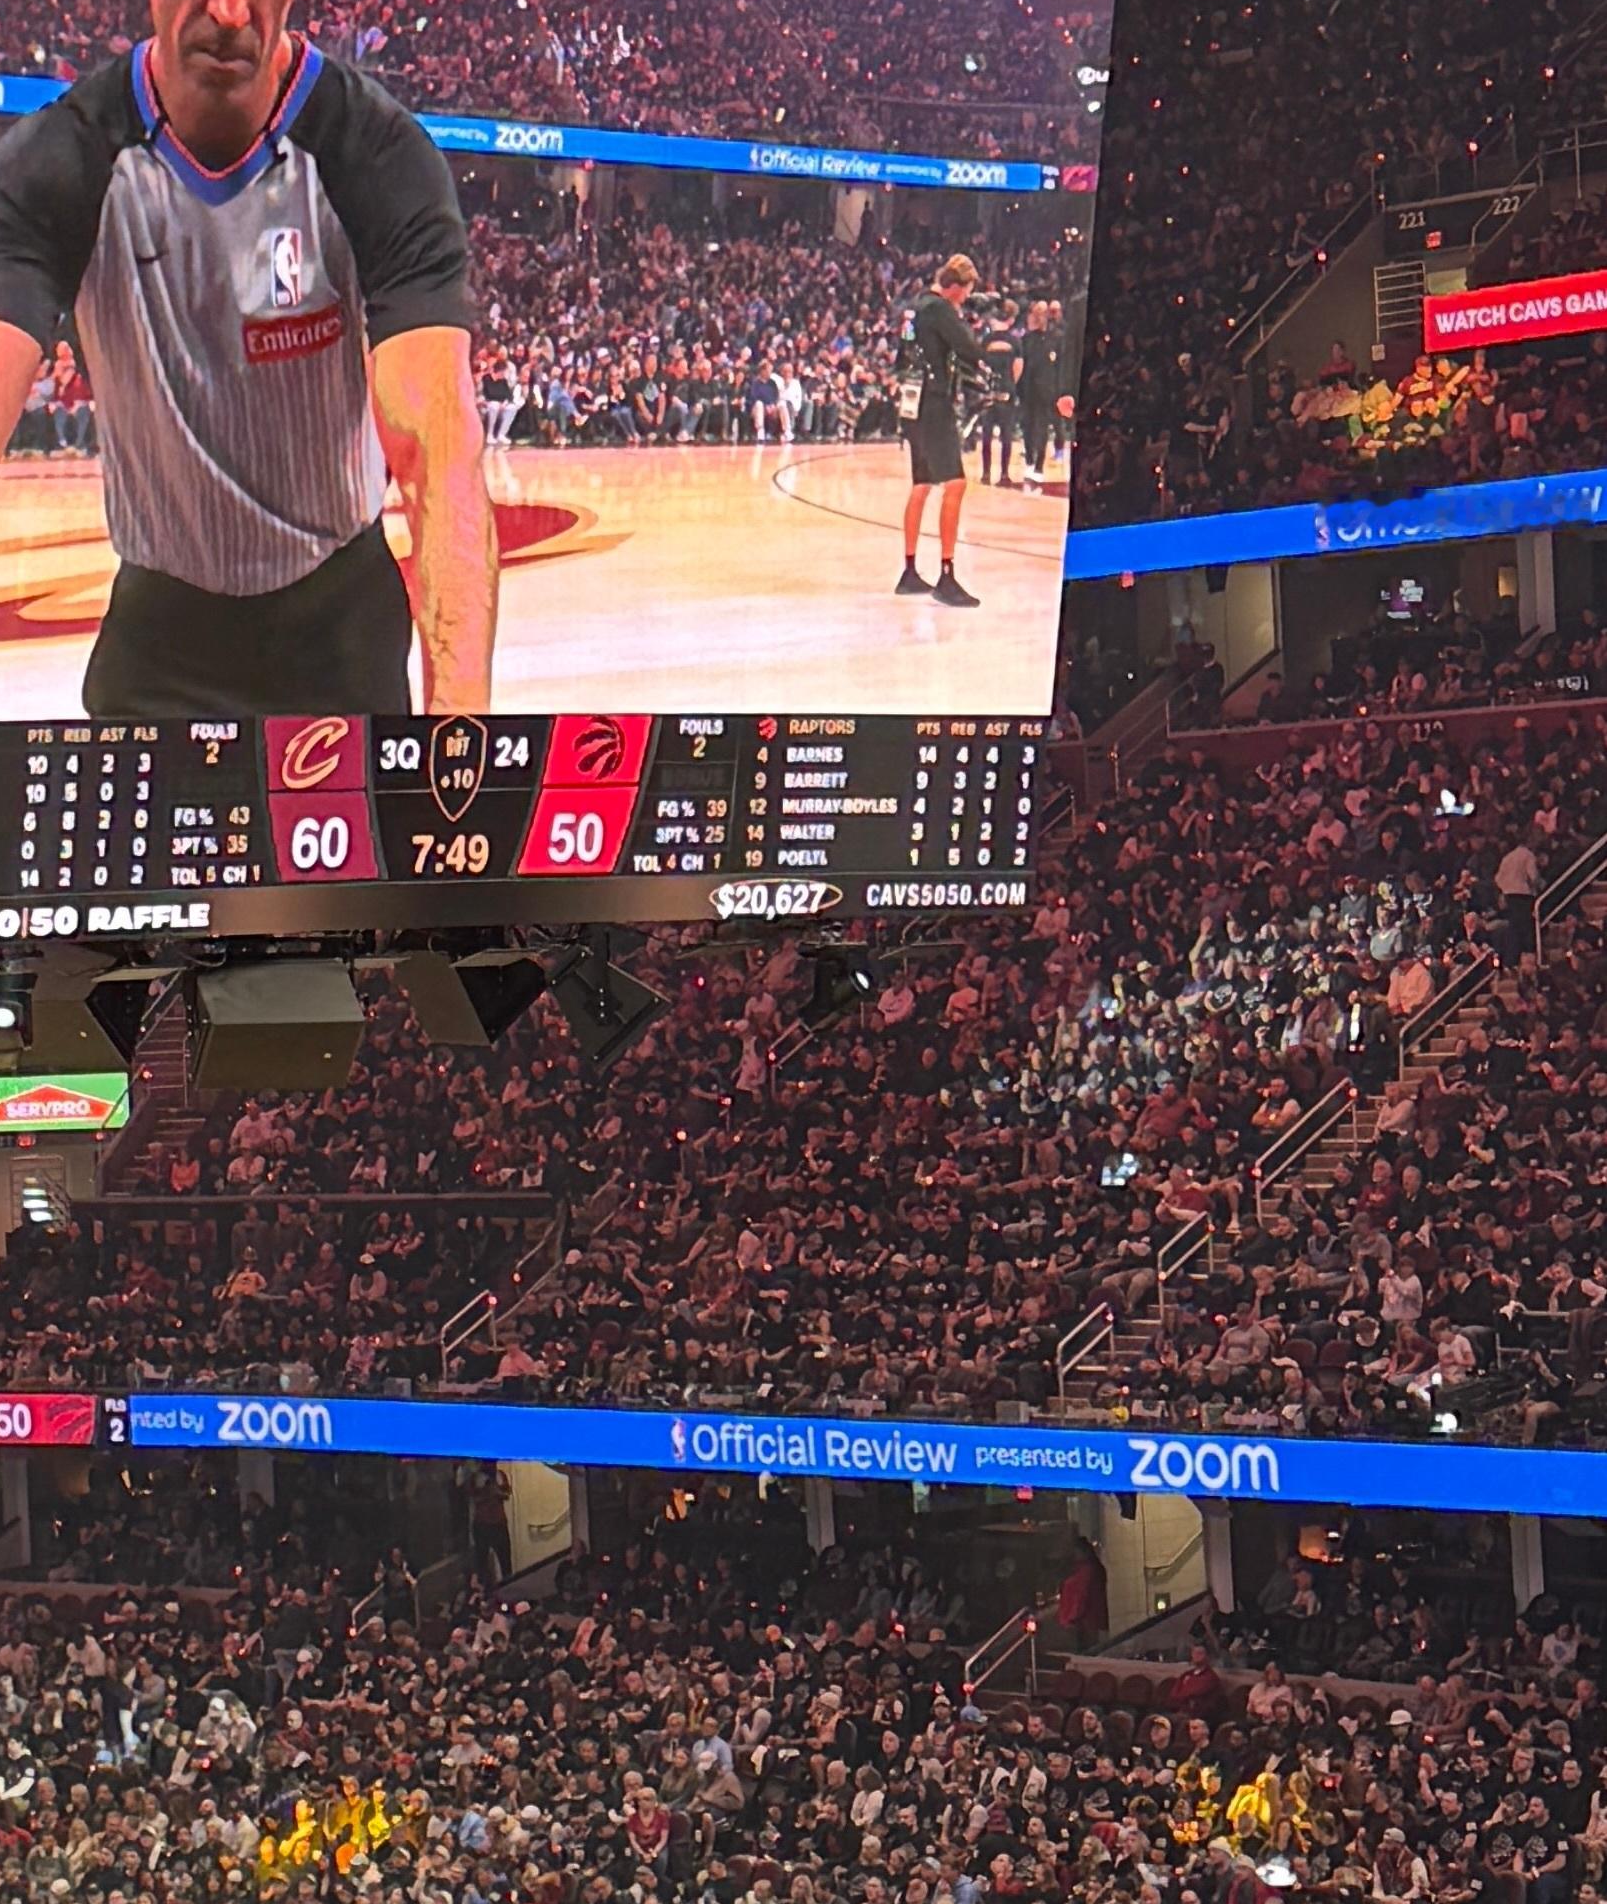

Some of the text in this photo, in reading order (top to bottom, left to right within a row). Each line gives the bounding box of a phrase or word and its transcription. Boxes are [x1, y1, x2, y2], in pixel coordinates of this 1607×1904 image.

[494, 124, 564, 153] zoom
[945, 162, 1008, 186] zoom
[1434, 289, 1607, 334] WATCH CAVS GAM
[678, 718, 725, 736] FOULS
[788, 719, 856, 736] RAPTORS
[916, 721, 942, 736] PTS
[984, 722, 1011, 737] AST
[1018, 722, 1044, 737] FLS
[378, 737, 422, 771] 3Q
[493, 736, 530, 768] 24
[692, 736, 707, 759] 2
[918, 745, 938, 765] 14
[27, 755, 49, 775] 10
[25, 784, 47, 804] 10
[228, 806, 251, 825] 43
[706, 799, 728, 817] 39
[749, 797, 768, 816] 12
[291, 815, 350, 870] 60
[546, 811, 605, 865] 50
[703, 825, 726, 844] 25
[779, 823, 836, 841] WALTER
[411, 834, 491, 875] 7:49
[633, 854, 704, 873] TOL CH
[745, 849, 764, 868] 19
[715, 881, 1027, 922] $20,627 CAVS5050.COM
[87, 902, 211, 933] RAFFLE
[5, 1099, 91, 1118] SERVPRO
[108, 1417, 126, 1443] 2
[216, 1400, 334, 1445] zoom
[691, 1423, 1281, 1493] Official Review presented by zoom
